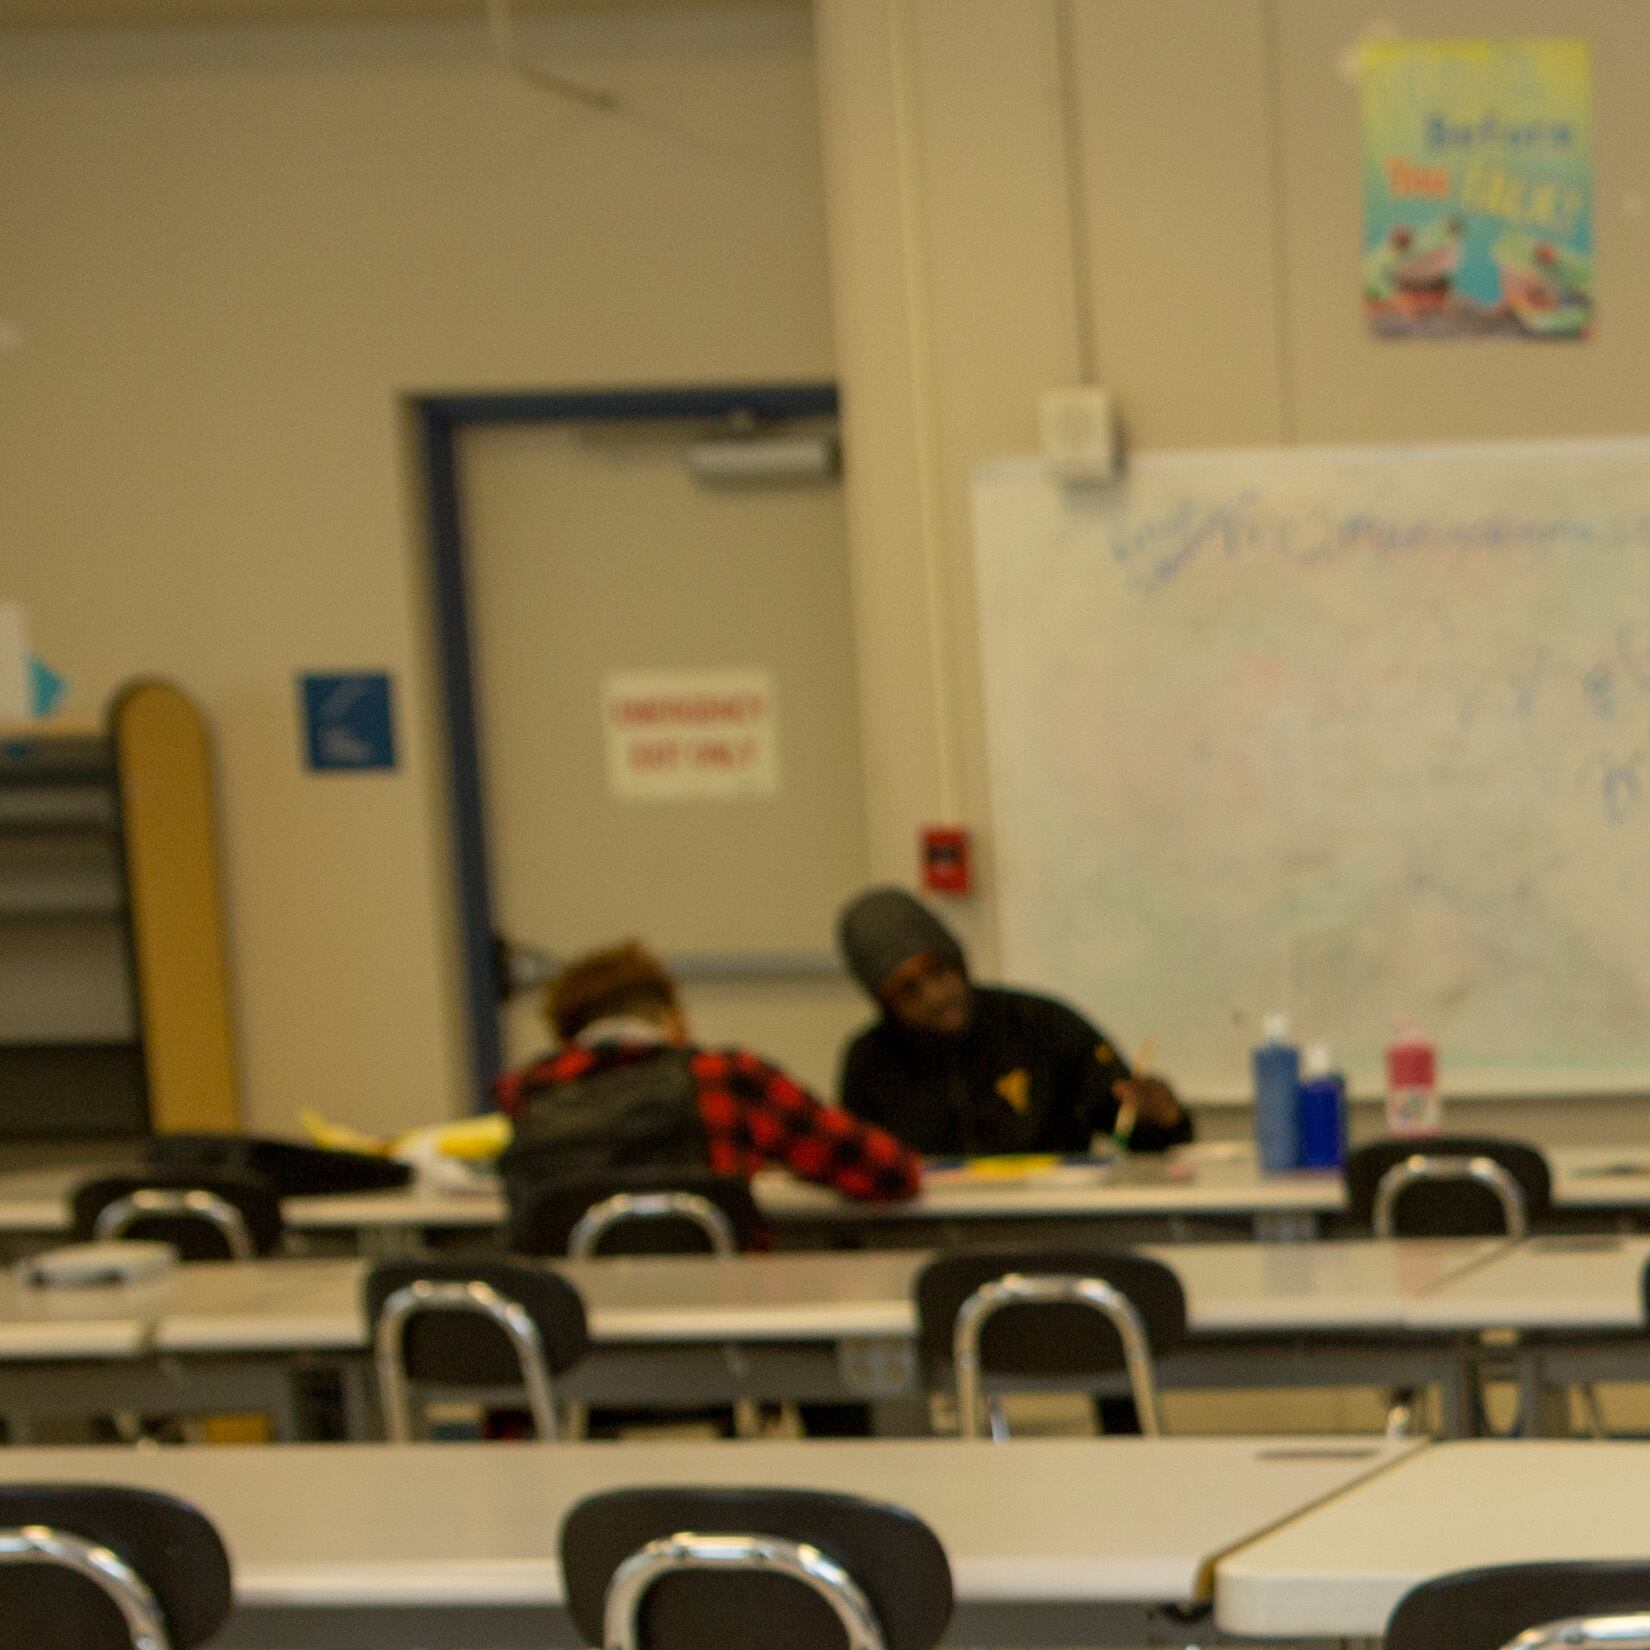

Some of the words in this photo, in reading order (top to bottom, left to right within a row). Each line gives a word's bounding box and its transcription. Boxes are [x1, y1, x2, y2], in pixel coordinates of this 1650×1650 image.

[1425, 110, 1573, 151] Before
[607, 693, 766, 727] EMERGENCY
[689, 738, 762, 773] ONLY
